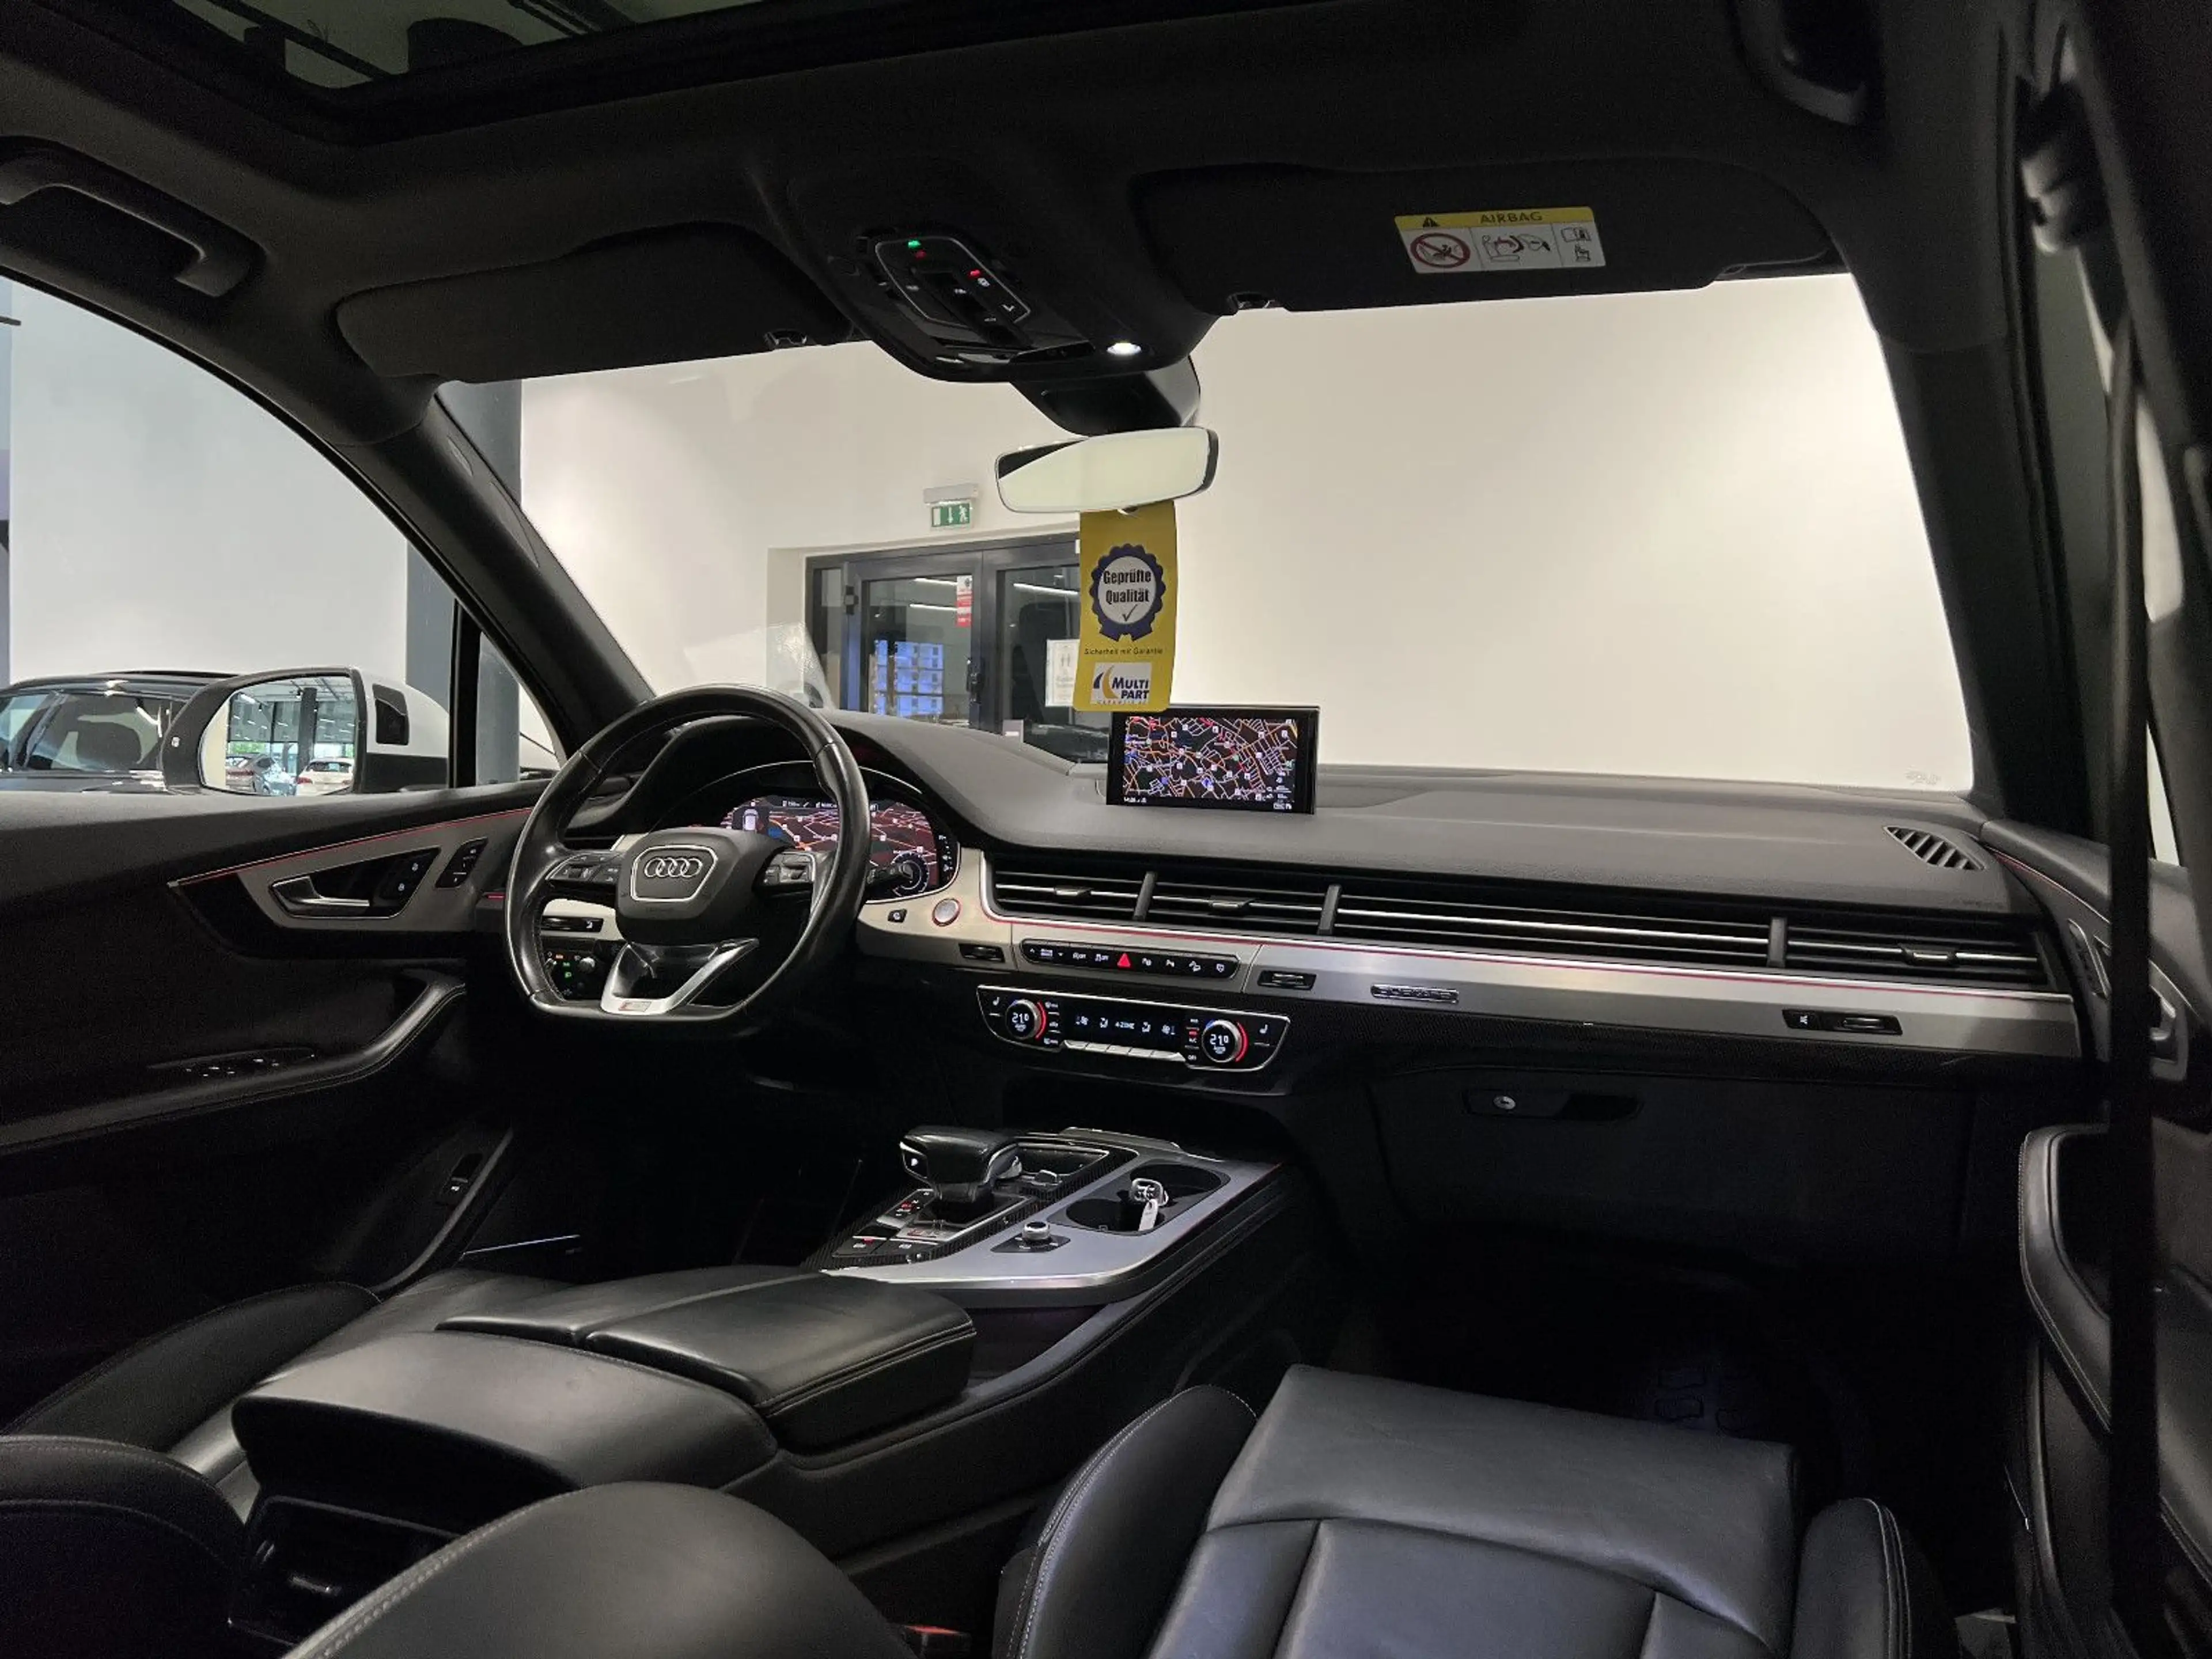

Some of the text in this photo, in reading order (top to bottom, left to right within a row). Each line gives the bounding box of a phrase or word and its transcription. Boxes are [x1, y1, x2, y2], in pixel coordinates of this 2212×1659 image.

[1480, 211, 1543, 224] AIRBAG
[1103, 568, 1152, 585] Geprüfte
[1106, 589, 1150, 605] Qualität
[1134, 647, 1164, 655] Garantie
[1112, 677, 1150, 690] MULTI
[1121, 690, 1150, 700] PART
